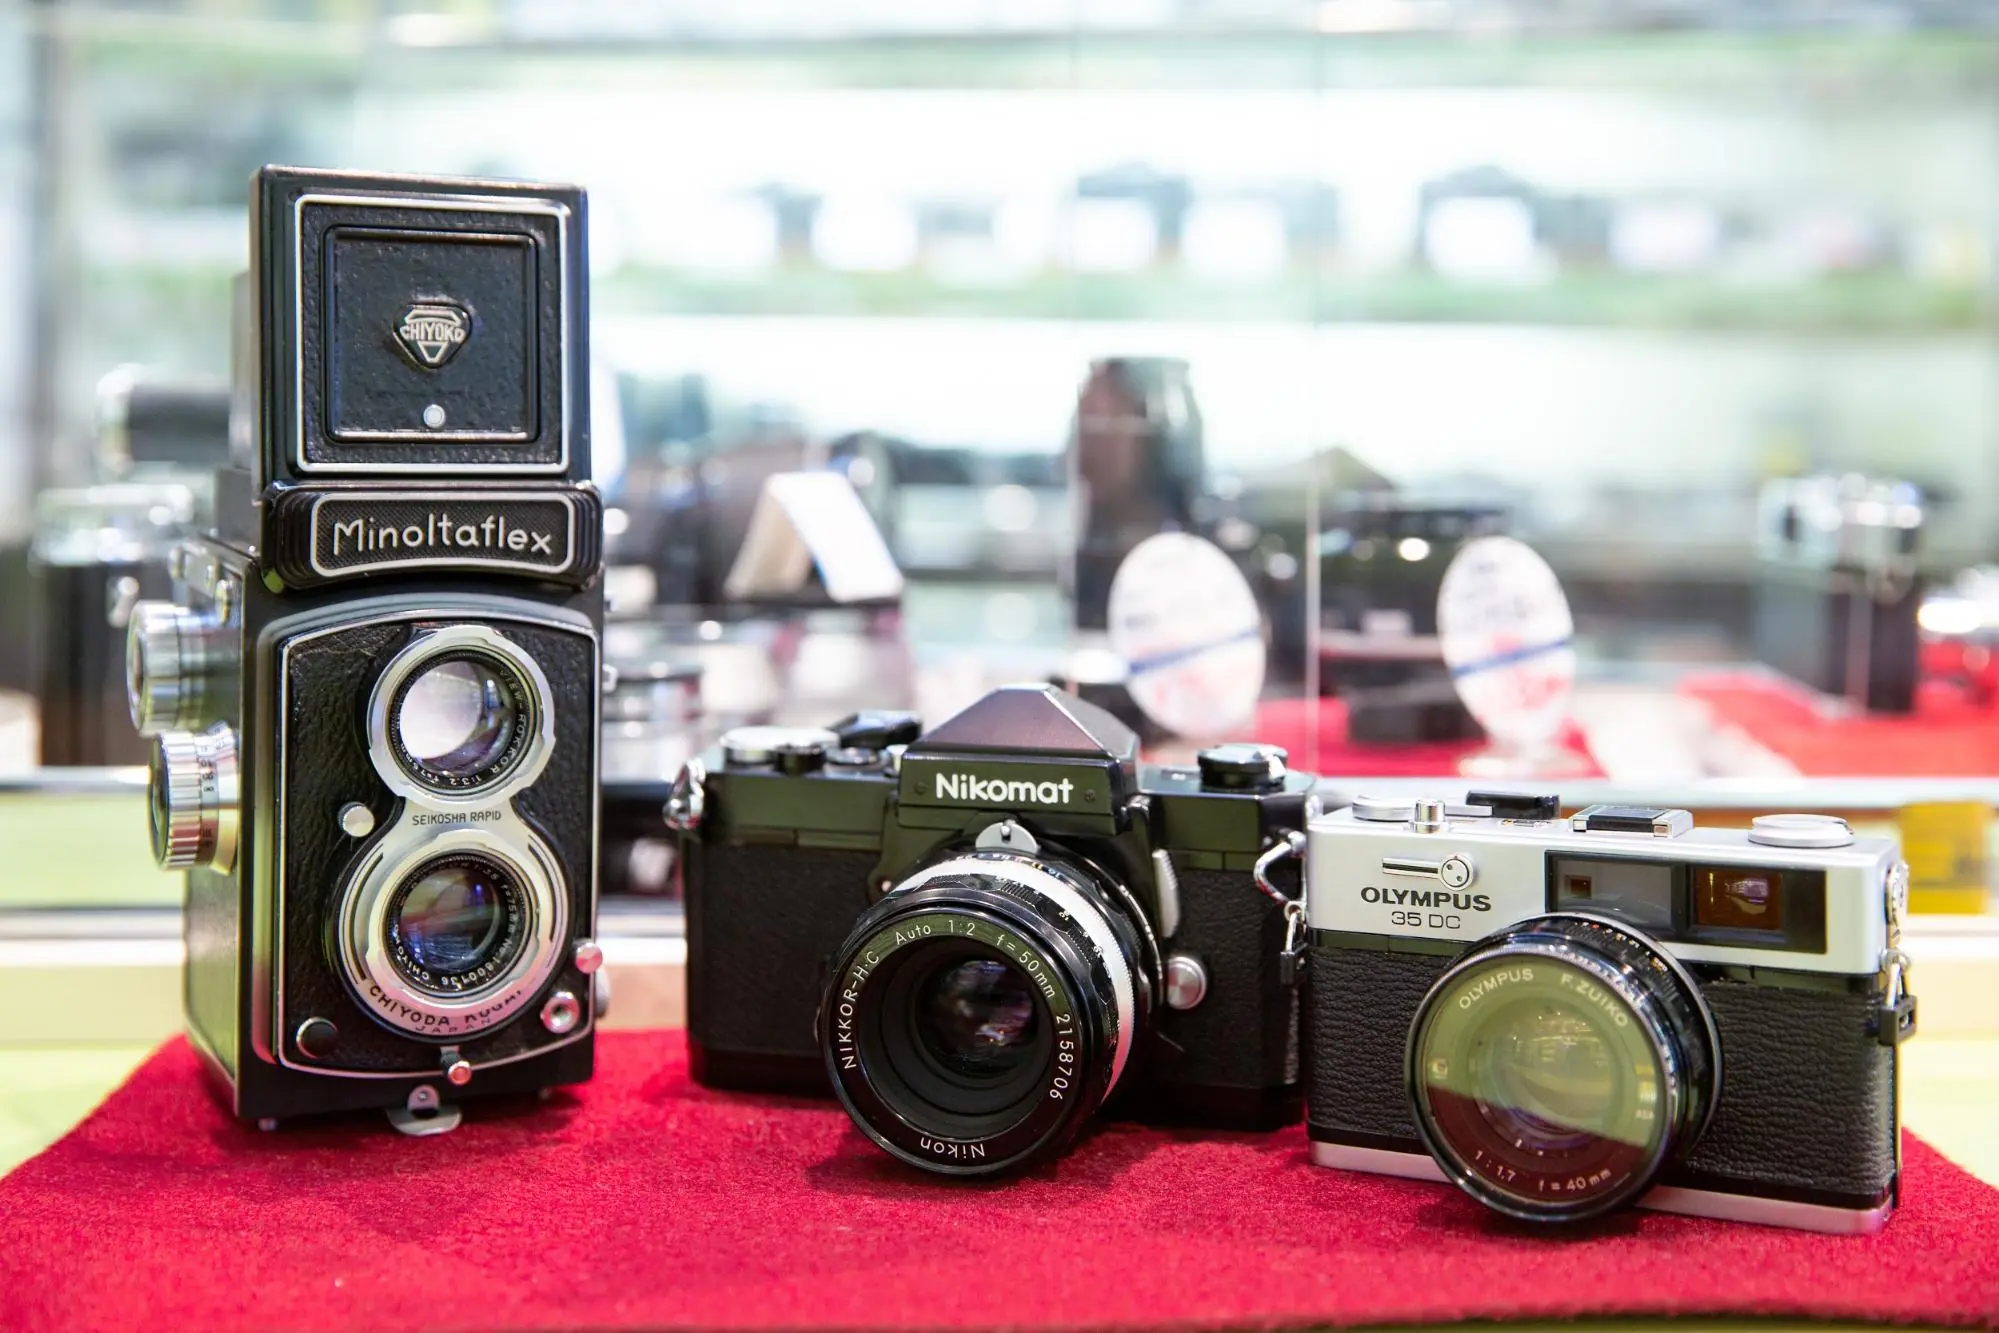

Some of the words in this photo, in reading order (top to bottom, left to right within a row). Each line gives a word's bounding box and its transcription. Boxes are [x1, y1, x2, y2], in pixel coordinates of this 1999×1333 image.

[399, 321, 467, 343] CHIYOKO
[333, 513, 553, 556] Minoltaflex
[935, 772, 1074, 805] Nikomat
[412, 812, 467, 826] SEIKOSHA
[470, 810, 502, 823] RAPID
[1360, 886, 1492, 912] OLYMPUS
[1391, 911, 1422, 928] 35
[1428, 913, 1461, 930] DC
[1458, 968, 1534, 1010] OLYMPUS
[369, 985, 450, 1026] CHIYODA
[895, 923, 932, 945] Auto
[1049, 1013, 1074, 1100] 2158706
[920, 1136, 986, 1159] Nikon
